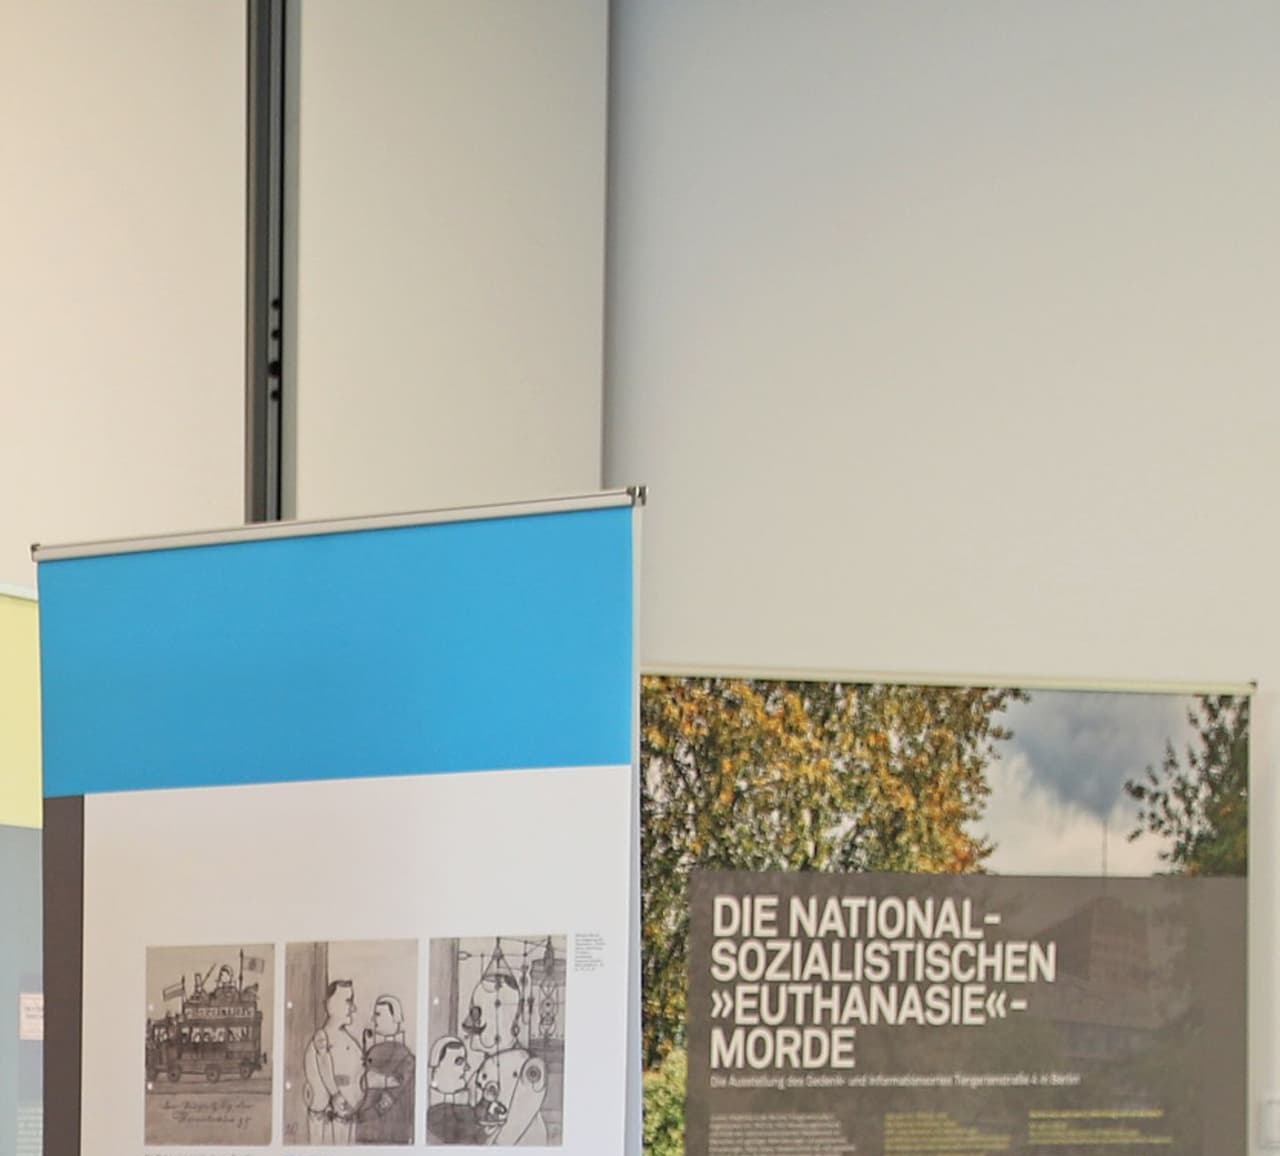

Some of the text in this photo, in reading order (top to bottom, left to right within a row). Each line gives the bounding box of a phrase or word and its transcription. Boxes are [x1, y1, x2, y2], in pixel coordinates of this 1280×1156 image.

[713, 896, 1001, 939] DIE NATIONAL-
[710, 939, 1056, 983] SOZIALISTISCHEN
[711, 984, 1027, 1026] »EUTHANASIE«-
[709, 1028, 856, 1069] MORDE
